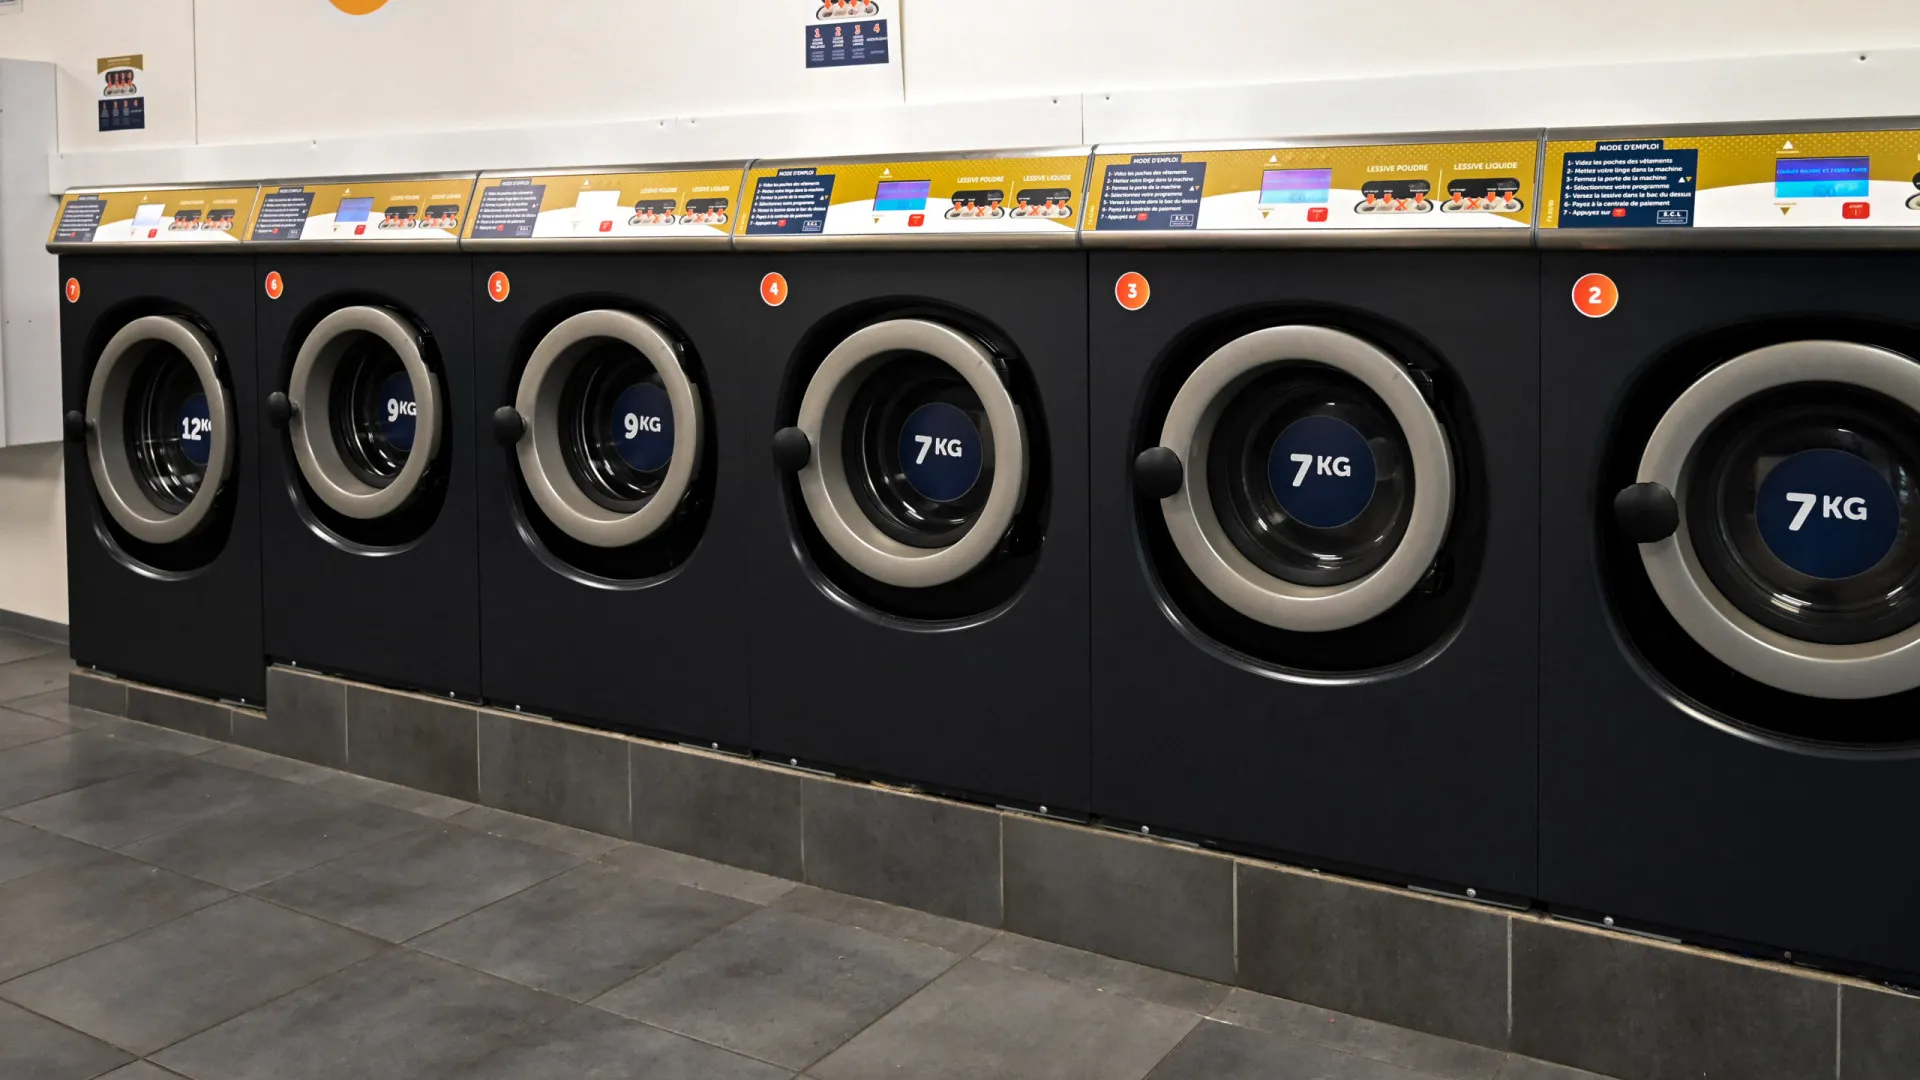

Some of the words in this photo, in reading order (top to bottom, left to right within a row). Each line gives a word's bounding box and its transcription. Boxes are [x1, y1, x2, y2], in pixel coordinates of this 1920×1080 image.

[873, 23, 880, 33] 4
[70, 286, 76, 294] 7
[271, 279, 277, 290] 6
[496, 280, 502, 292] 5
[770, 282, 778, 295] 4
[1128, 284, 1138, 298] 3
[1588, 287, 1602, 304] 2
